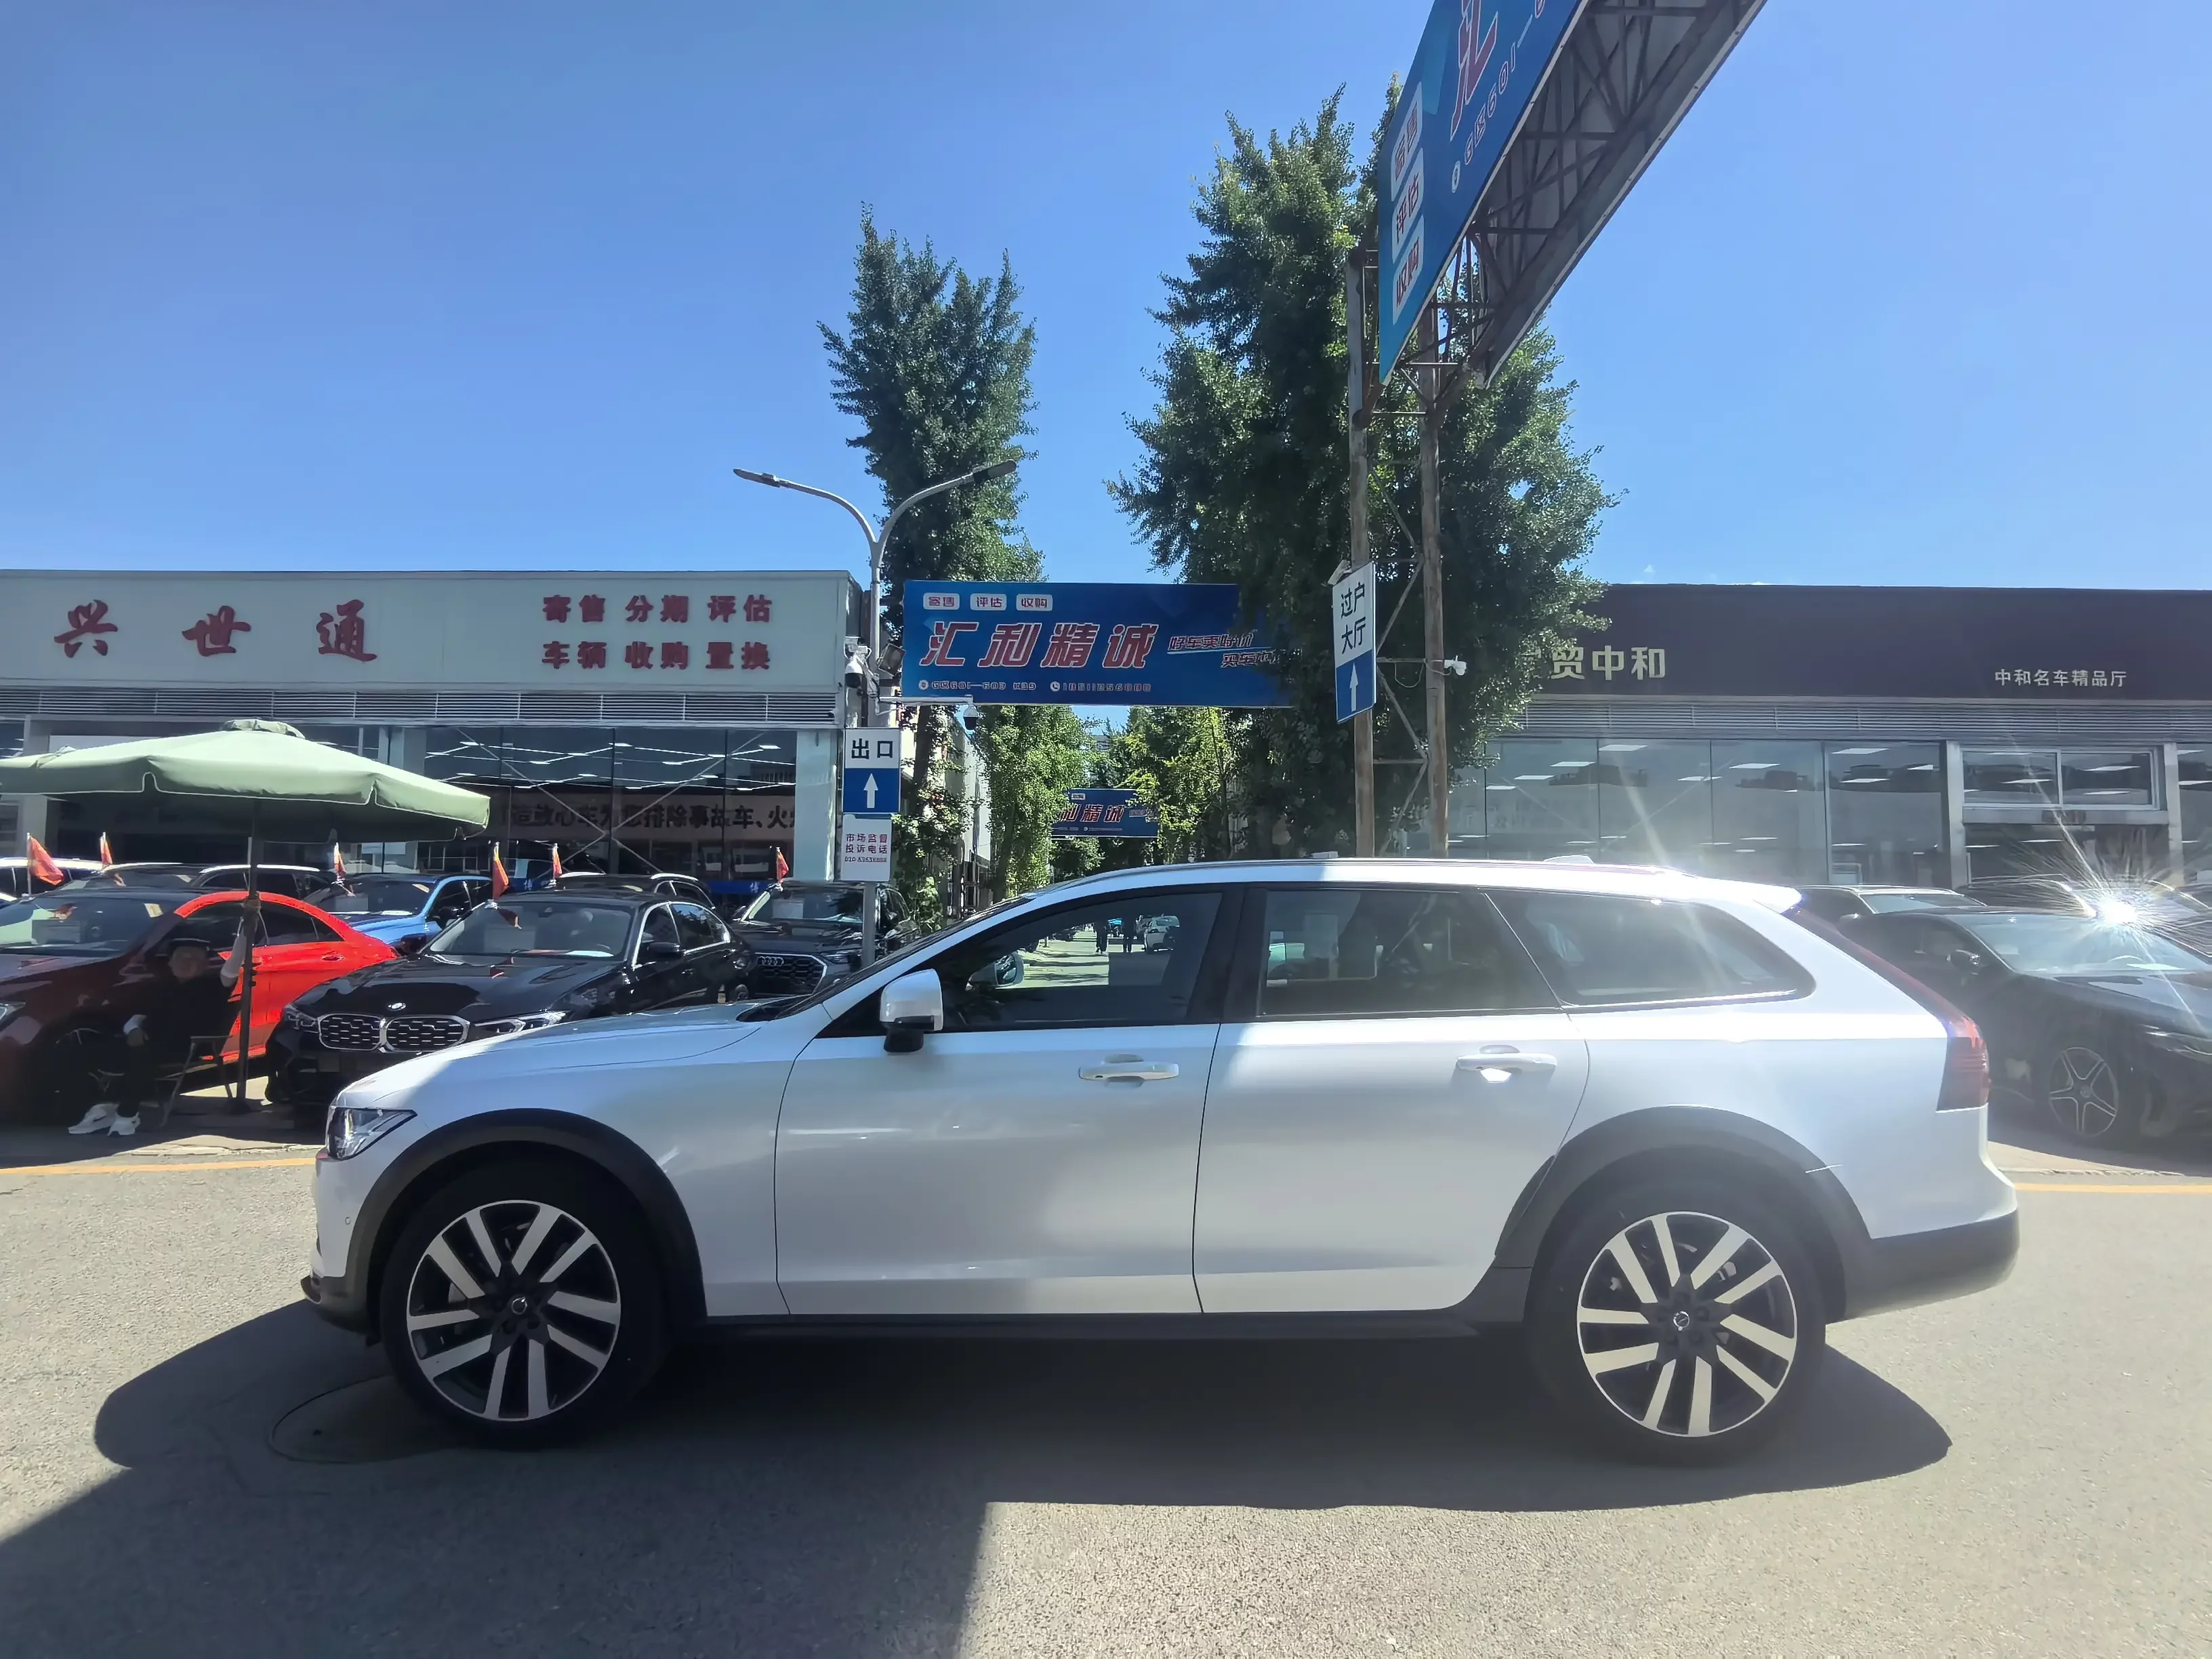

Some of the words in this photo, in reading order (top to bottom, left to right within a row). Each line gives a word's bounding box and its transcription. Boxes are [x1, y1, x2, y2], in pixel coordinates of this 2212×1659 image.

[1397, 171, 1419, 245] 评估
[1396, 236, 1419, 308] 收购
[542, 594, 606, 623] 寄售
[624, 594, 690, 623] 分期
[707, 594, 773, 623] 评估
[977, 596, 1003, 608] 评估
[1021, 598, 1048, 609] 收购
[1340, 581, 1366, 619] 过户
[54, 599, 377, 663] 兴世通
[919, 621, 1159, 668] 汇利精诚
[1341, 616, 1366, 655] 大厅
[541, 640, 607, 670] 车辆
[624, 641, 689, 670] 收购
[705, 641, 771, 670] 置换
[1994, 669, 2127, 687] 中和名车精品厅
[851, 738, 893, 760] 出口
[845, 844, 888, 854] 投诉电话
